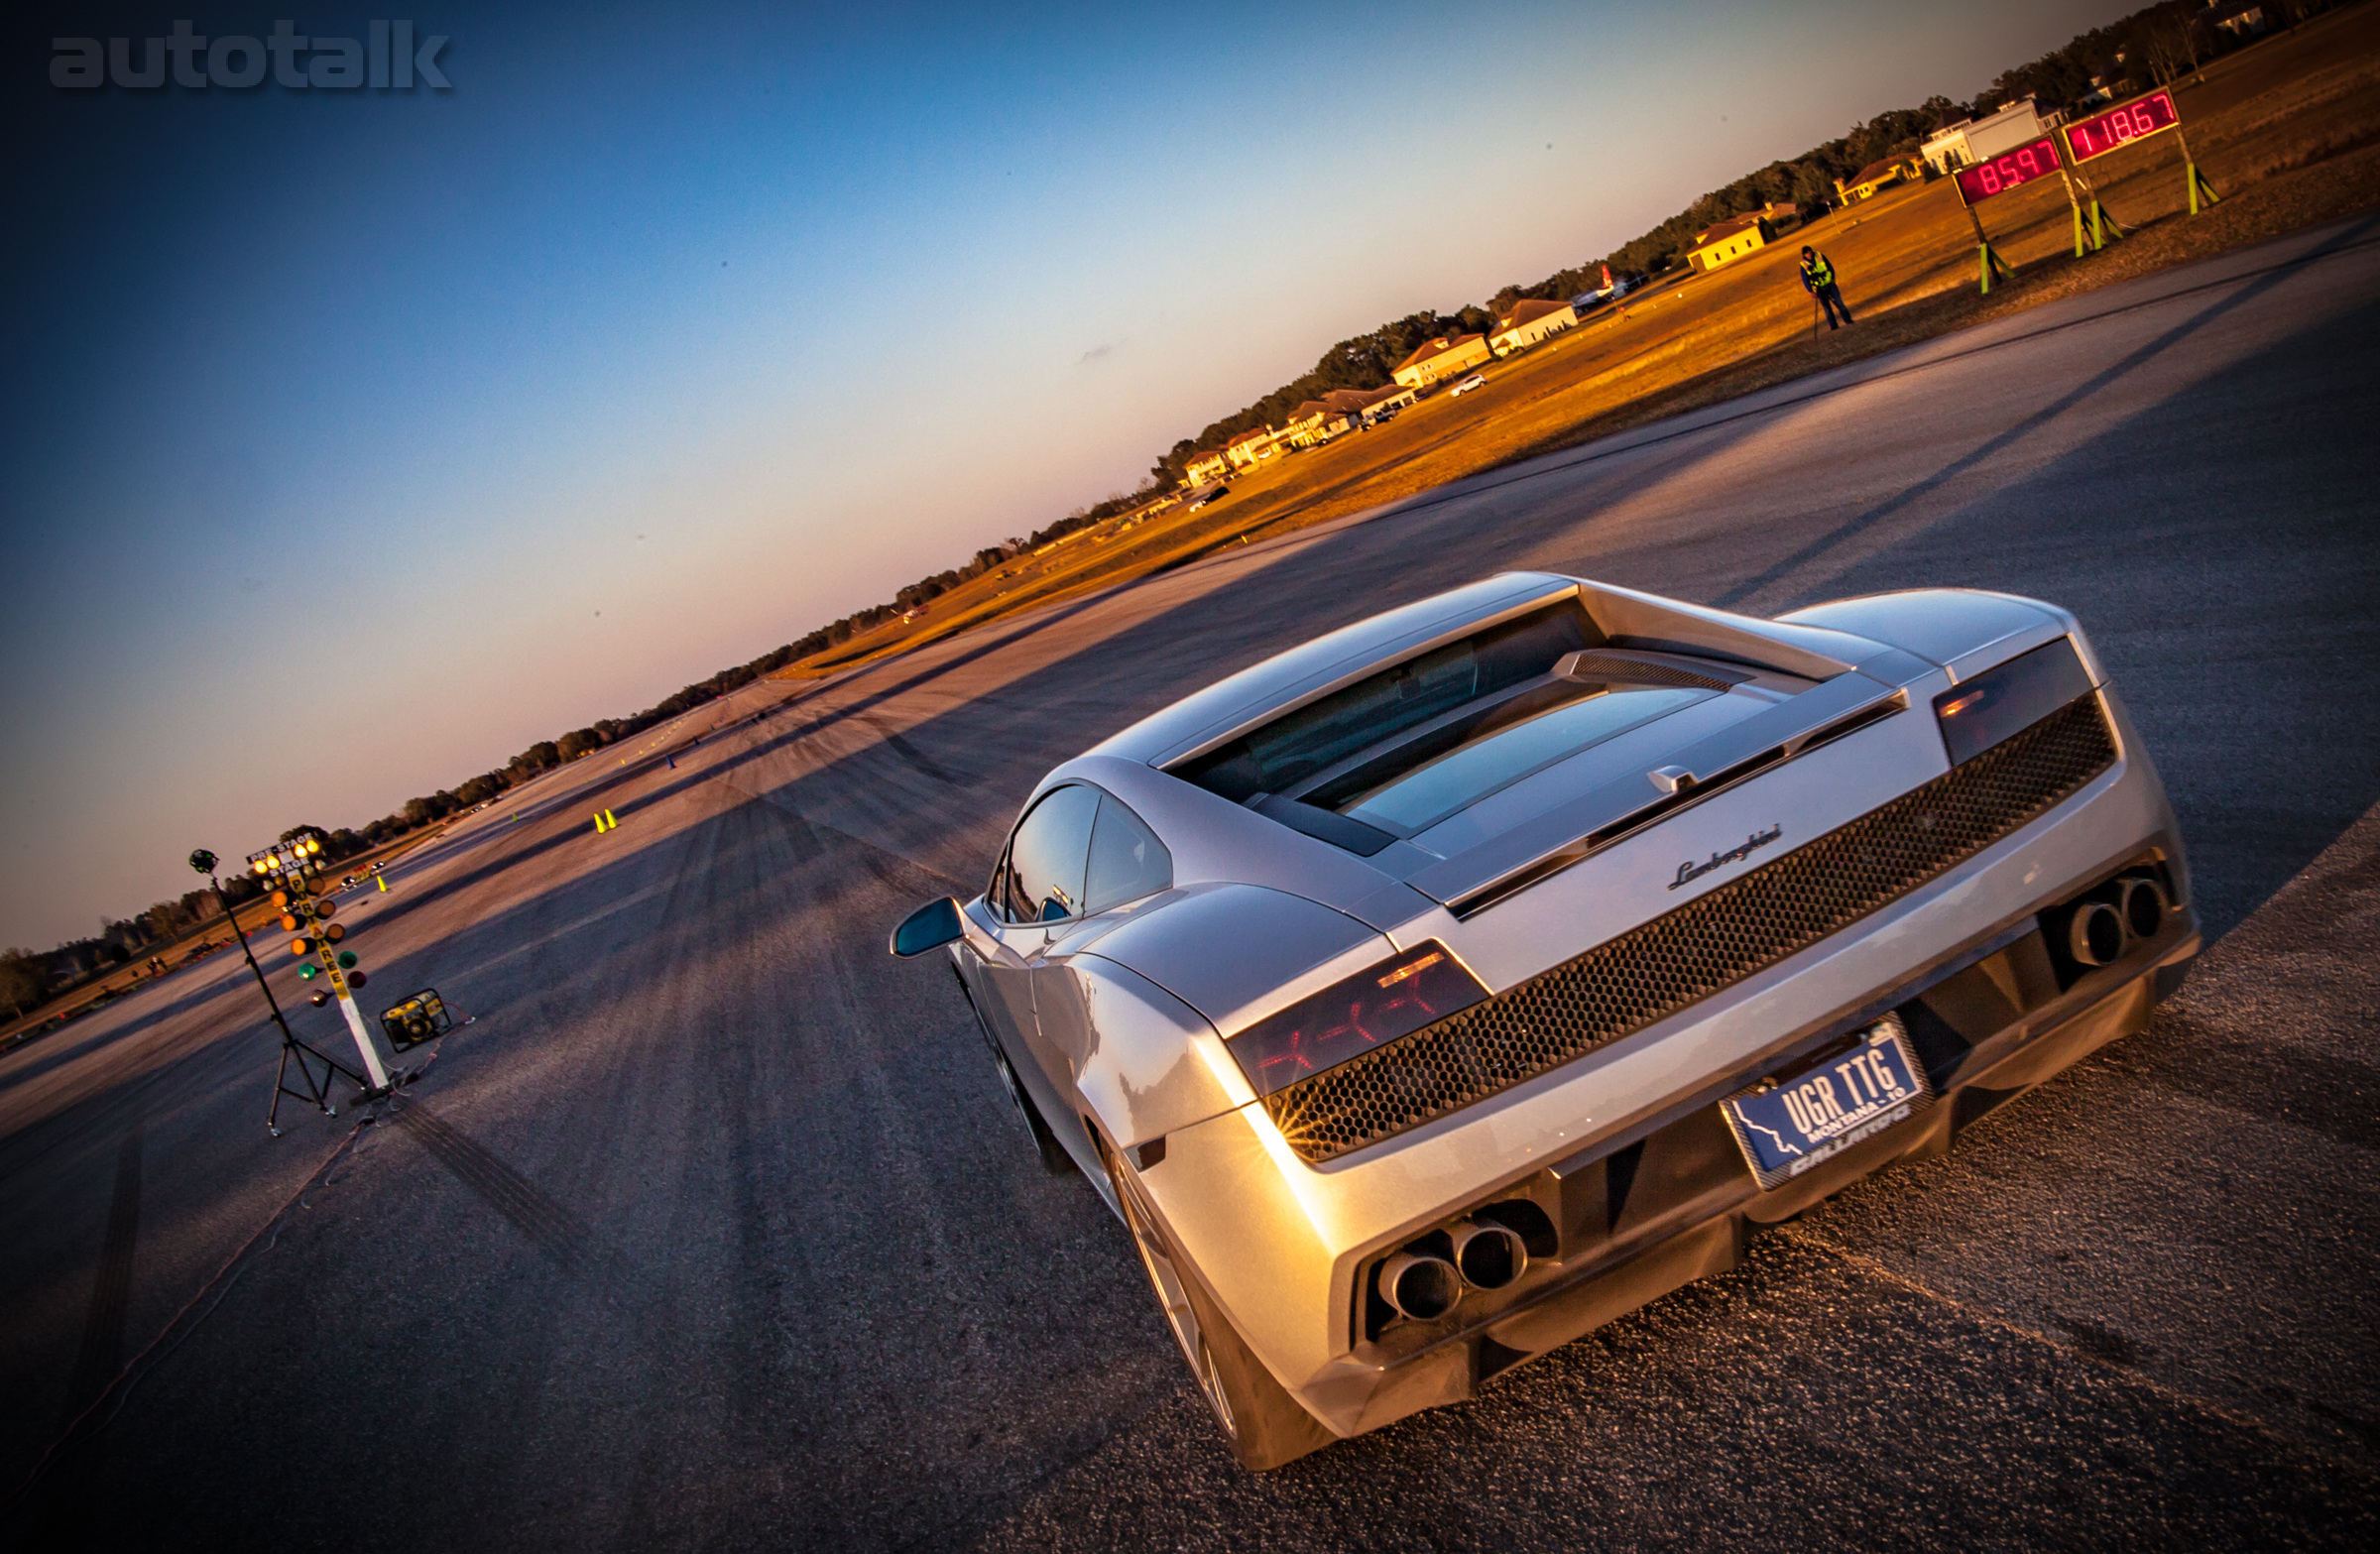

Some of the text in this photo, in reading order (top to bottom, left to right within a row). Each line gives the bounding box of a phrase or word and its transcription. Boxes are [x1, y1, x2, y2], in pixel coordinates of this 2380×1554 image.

[2080, 93, 2176, 152] 118.67
[1977, 140, 2060, 194] 85.97
[250, 832, 313, 862] PRE-STAGE
[269, 857, 309, 878] STAGE
[1667, 823, 1783, 891] Lamborghini
[1781, 1048, 1897, 1136] UGR TTG
[1807, 1101, 1880, 1144] MONTANA
